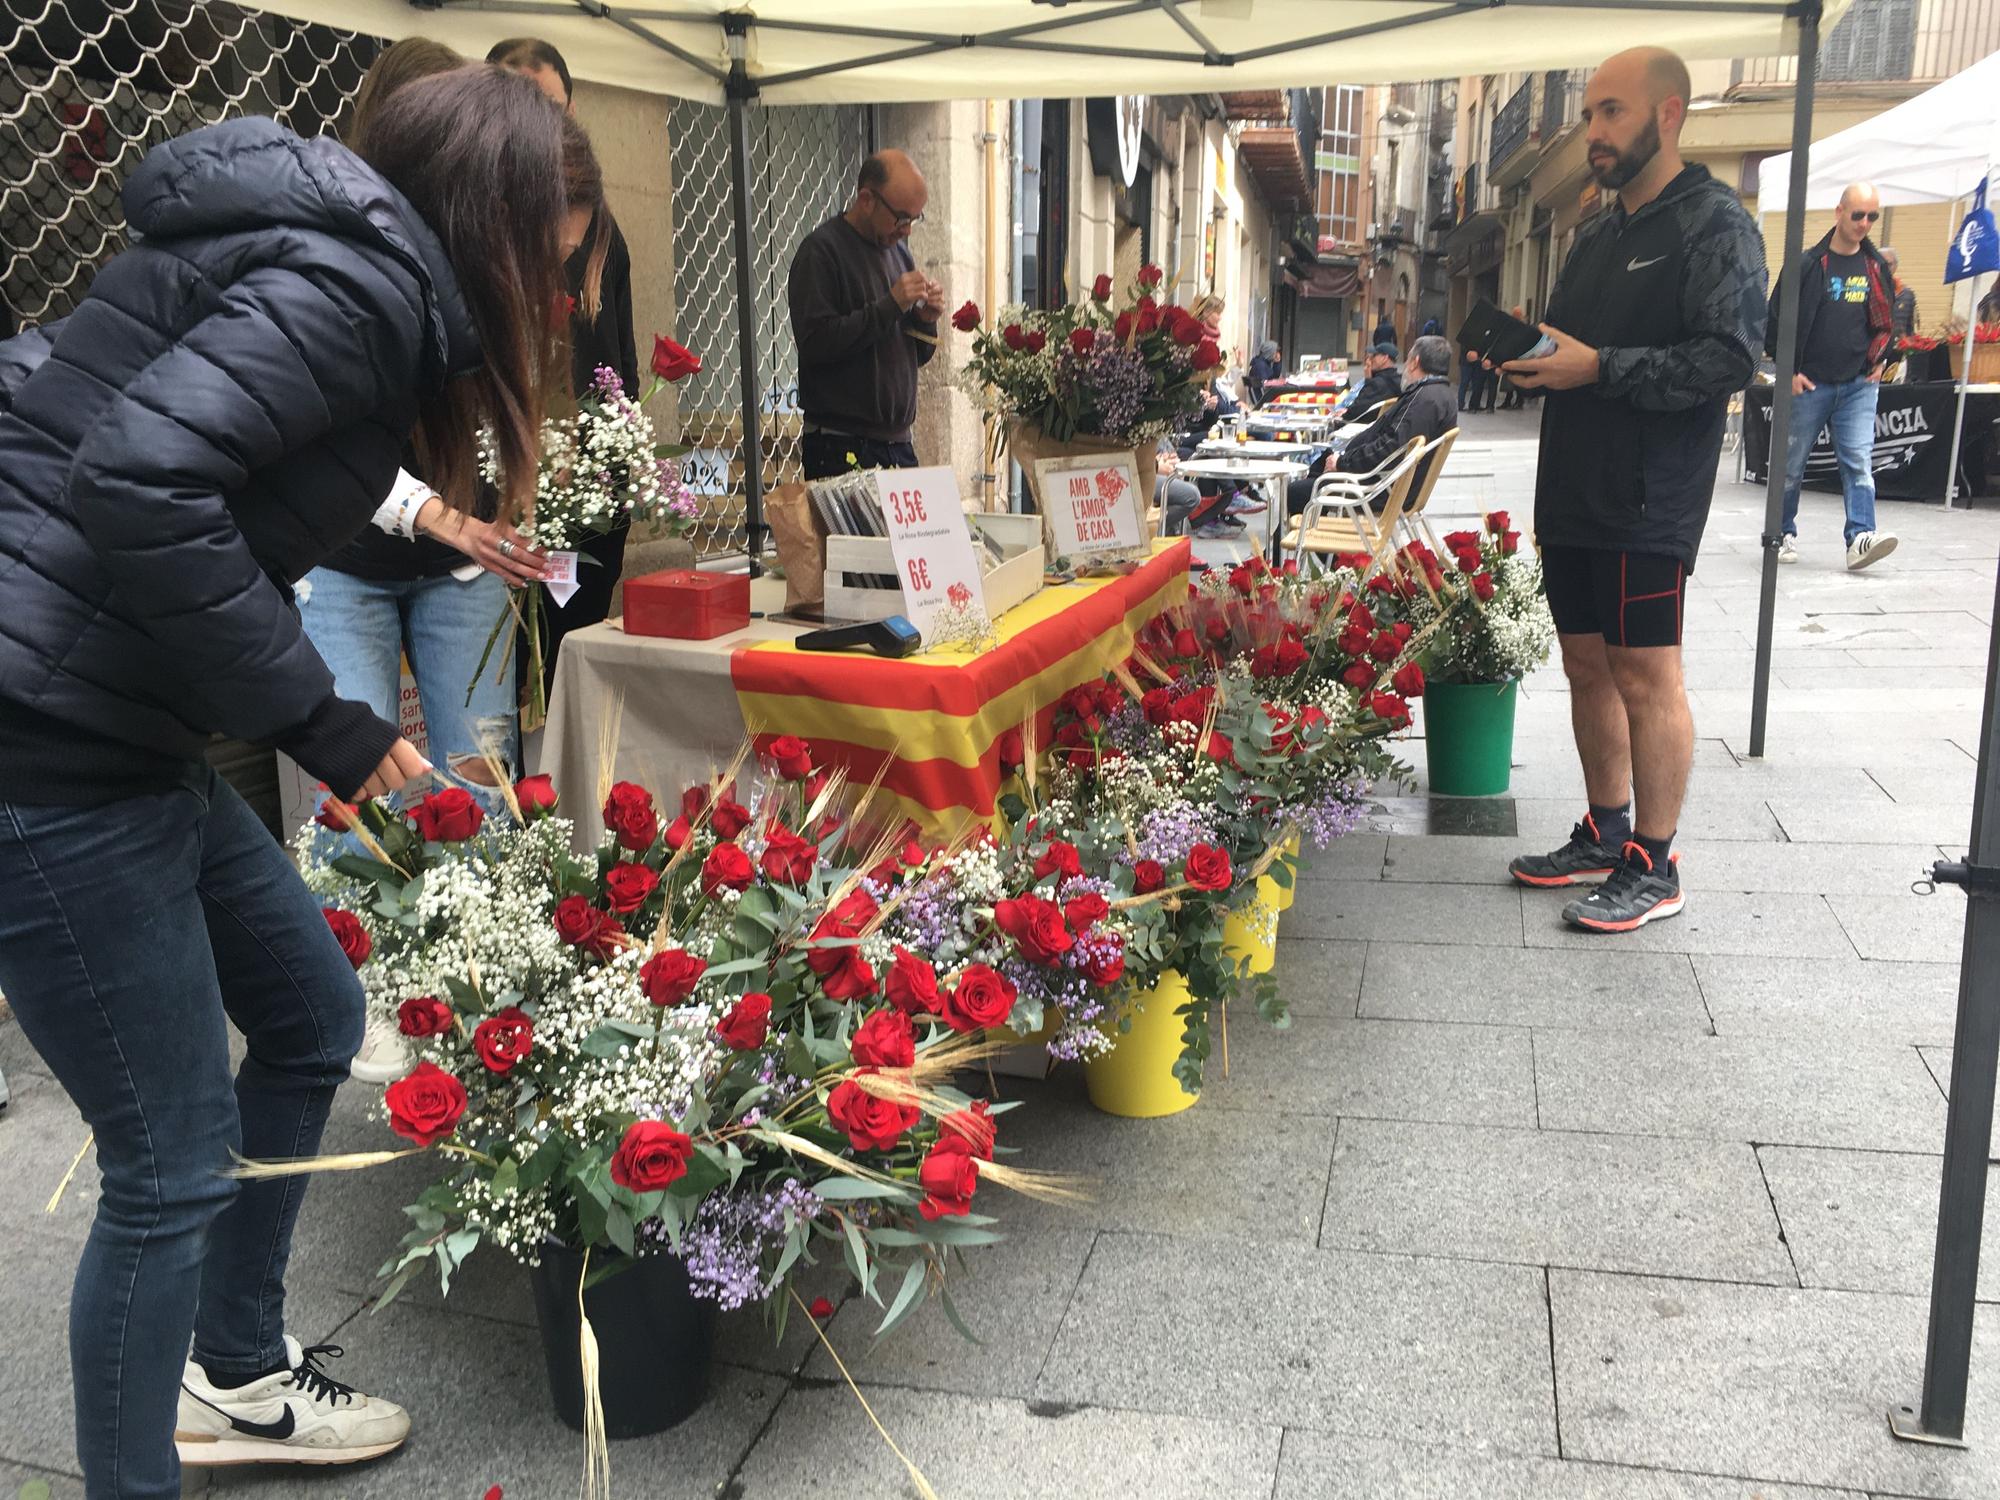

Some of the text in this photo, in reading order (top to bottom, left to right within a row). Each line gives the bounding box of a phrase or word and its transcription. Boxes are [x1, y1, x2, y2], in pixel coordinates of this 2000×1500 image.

[1069, 477, 1091, 498] AMB
[889, 489, 927, 528] 3,5€
[1072, 498, 1107, 520] L'AMOR
[1076, 518, 1116, 542] DE CASA
[907, 557, 932, 592] 6€
